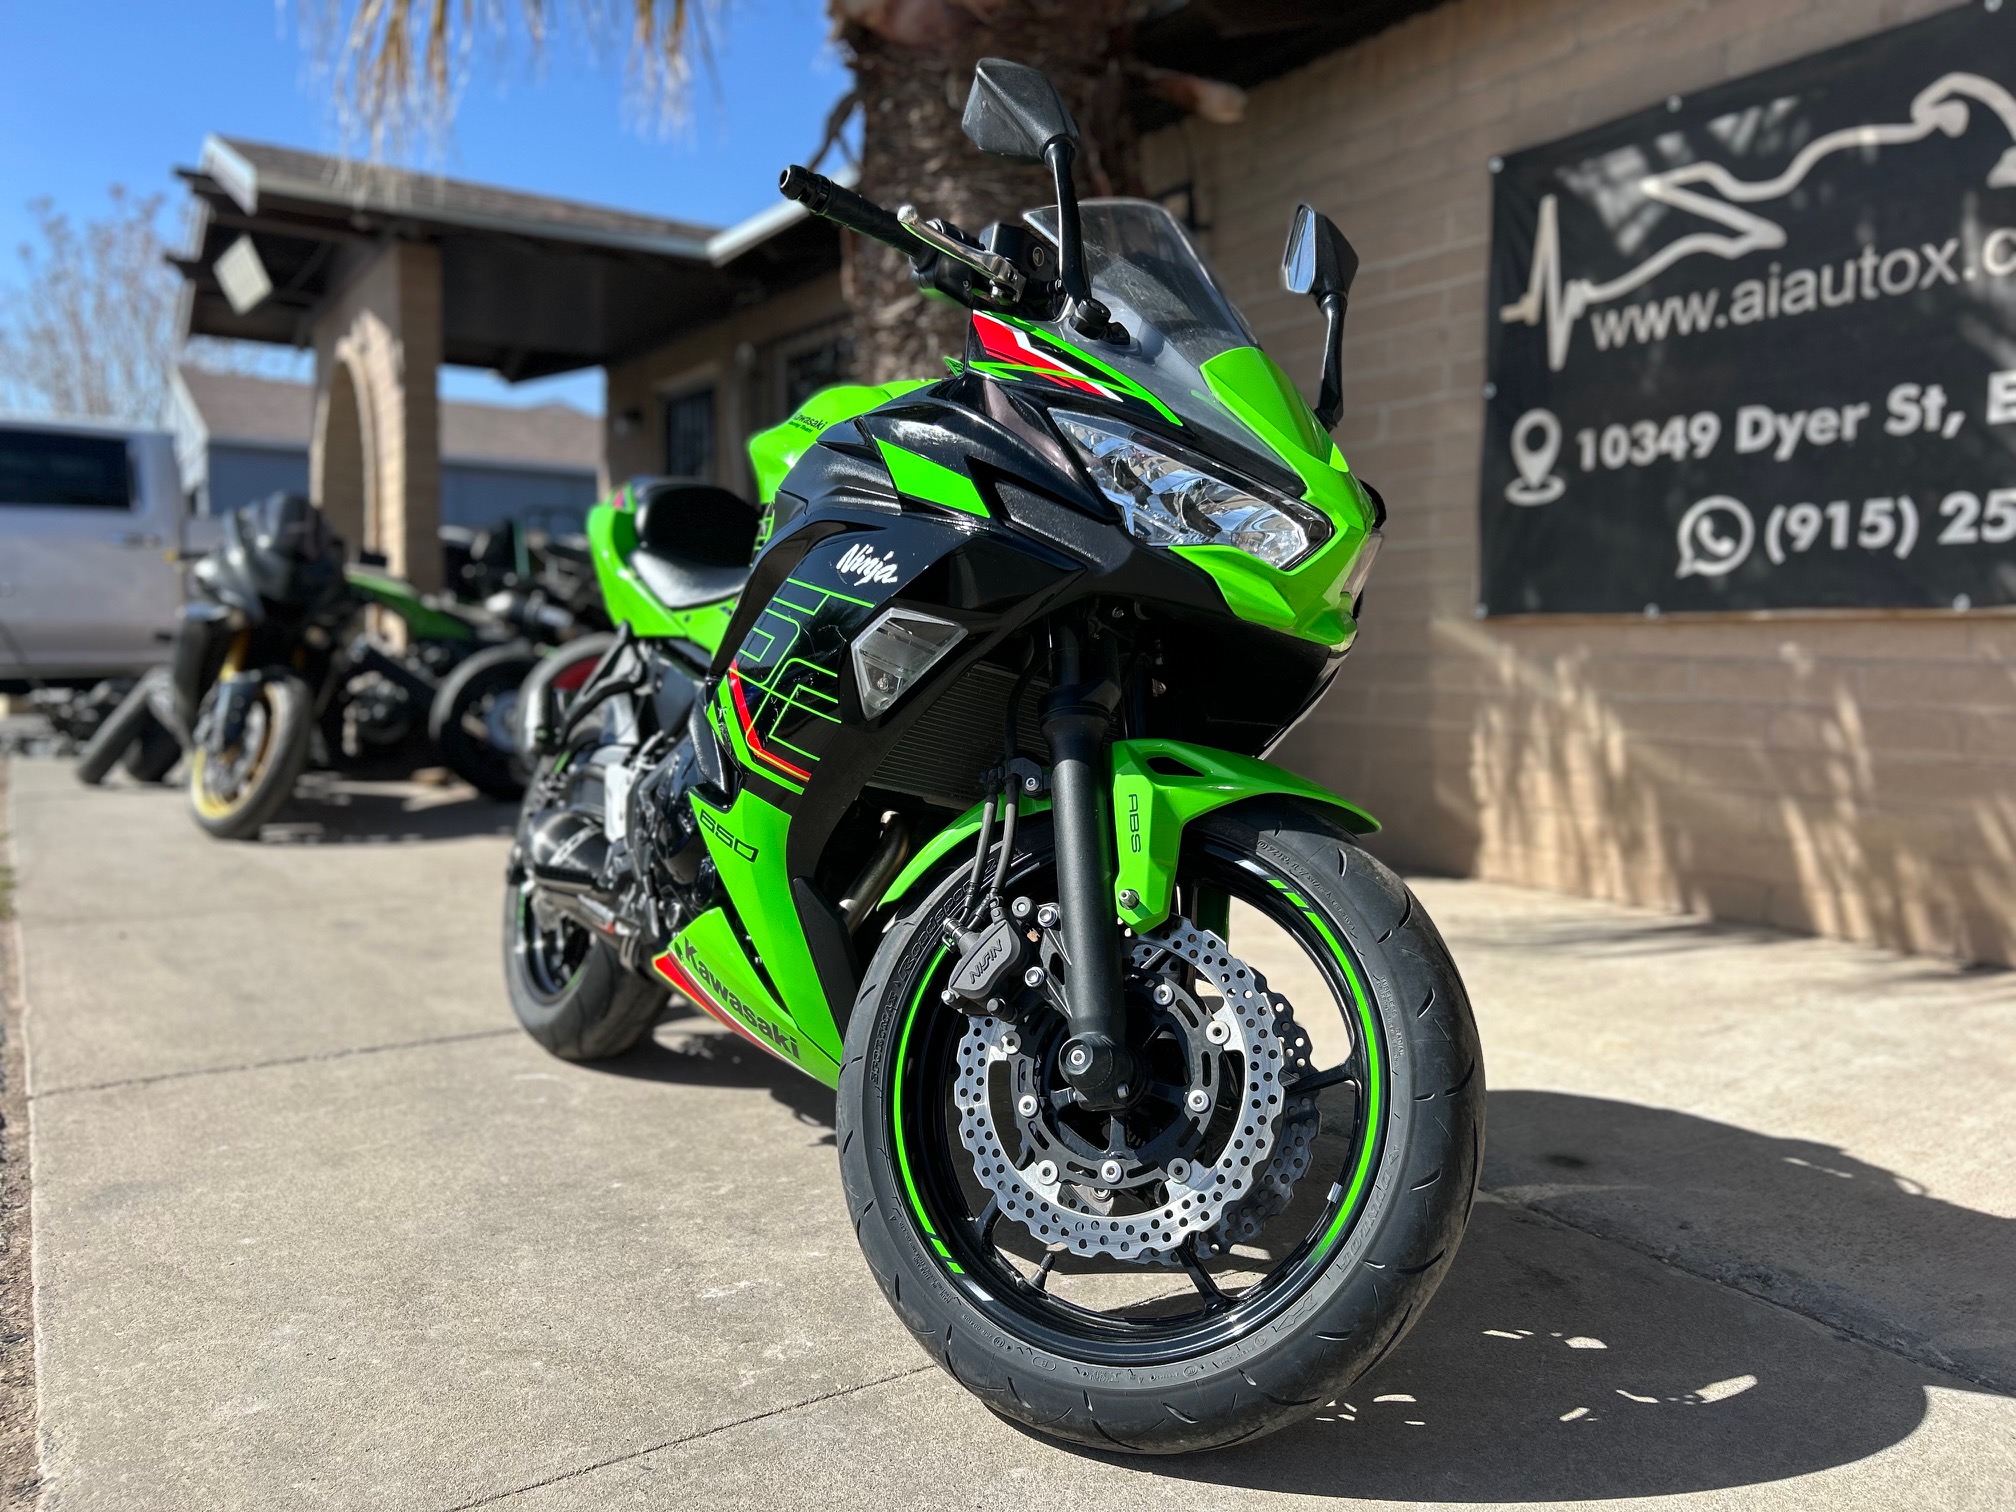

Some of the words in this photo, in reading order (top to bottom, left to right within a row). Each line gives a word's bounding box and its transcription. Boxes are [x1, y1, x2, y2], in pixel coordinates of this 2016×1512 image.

[1577, 411, 1721, 472] 10349
[1734, 398, 1870, 461] Dyer
[1884, 382, 1966, 440] St,
[1765, 494, 1919, 564] (915)
[836, 544, 898, 585] Ninja
[699, 808, 759, 863] 650
[1128, 793, 1142, 853] ABS
[684, 936, 800, 1060] Kawasaki
